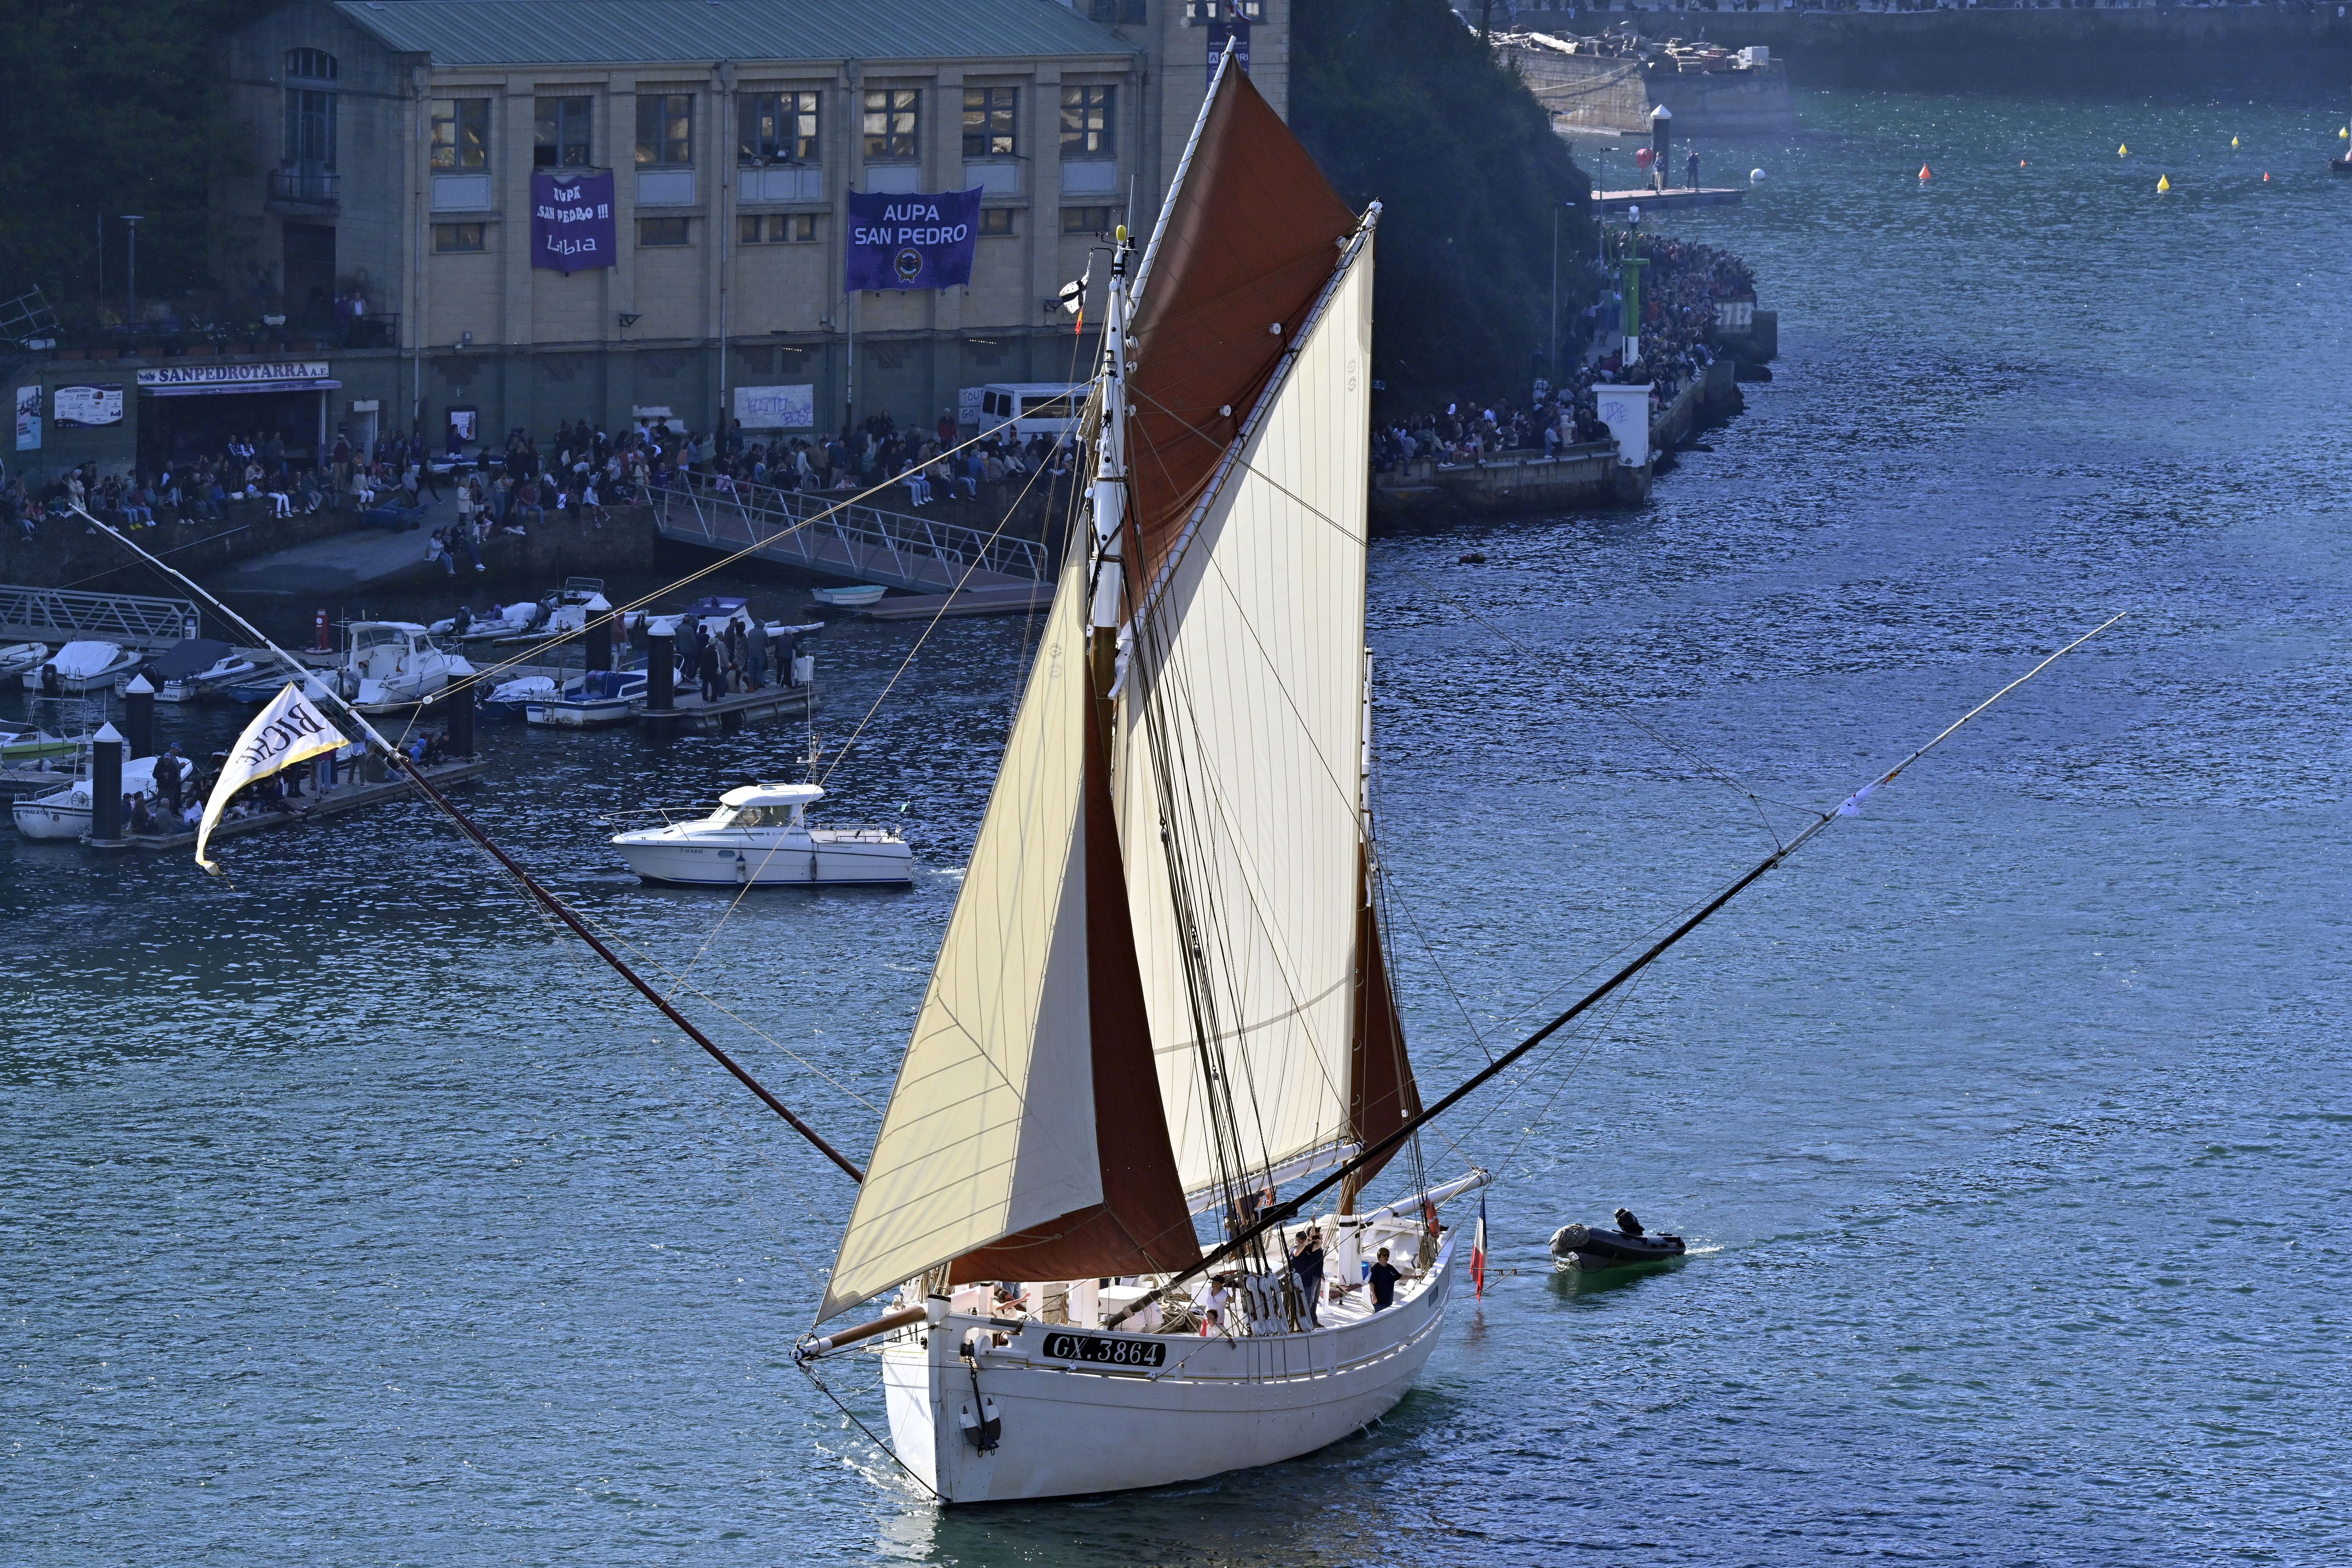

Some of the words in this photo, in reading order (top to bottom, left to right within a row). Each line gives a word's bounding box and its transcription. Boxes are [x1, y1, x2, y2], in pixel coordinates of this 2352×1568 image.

[554, 186, 581, 202] AUPA
[537, 205, 555, 220] SAN
[557, 207, 593, 223] PEDRO
[883, 204, 939, 221] AUPA
[855, 228, 891, 244] SAN
[898, 224, 967, 245] PEDRO
[159, 363, 308, 382] SANPEDROTARRA
[310, 367, 329, 377] A.E.
[962, 409, 974, 418] GO
